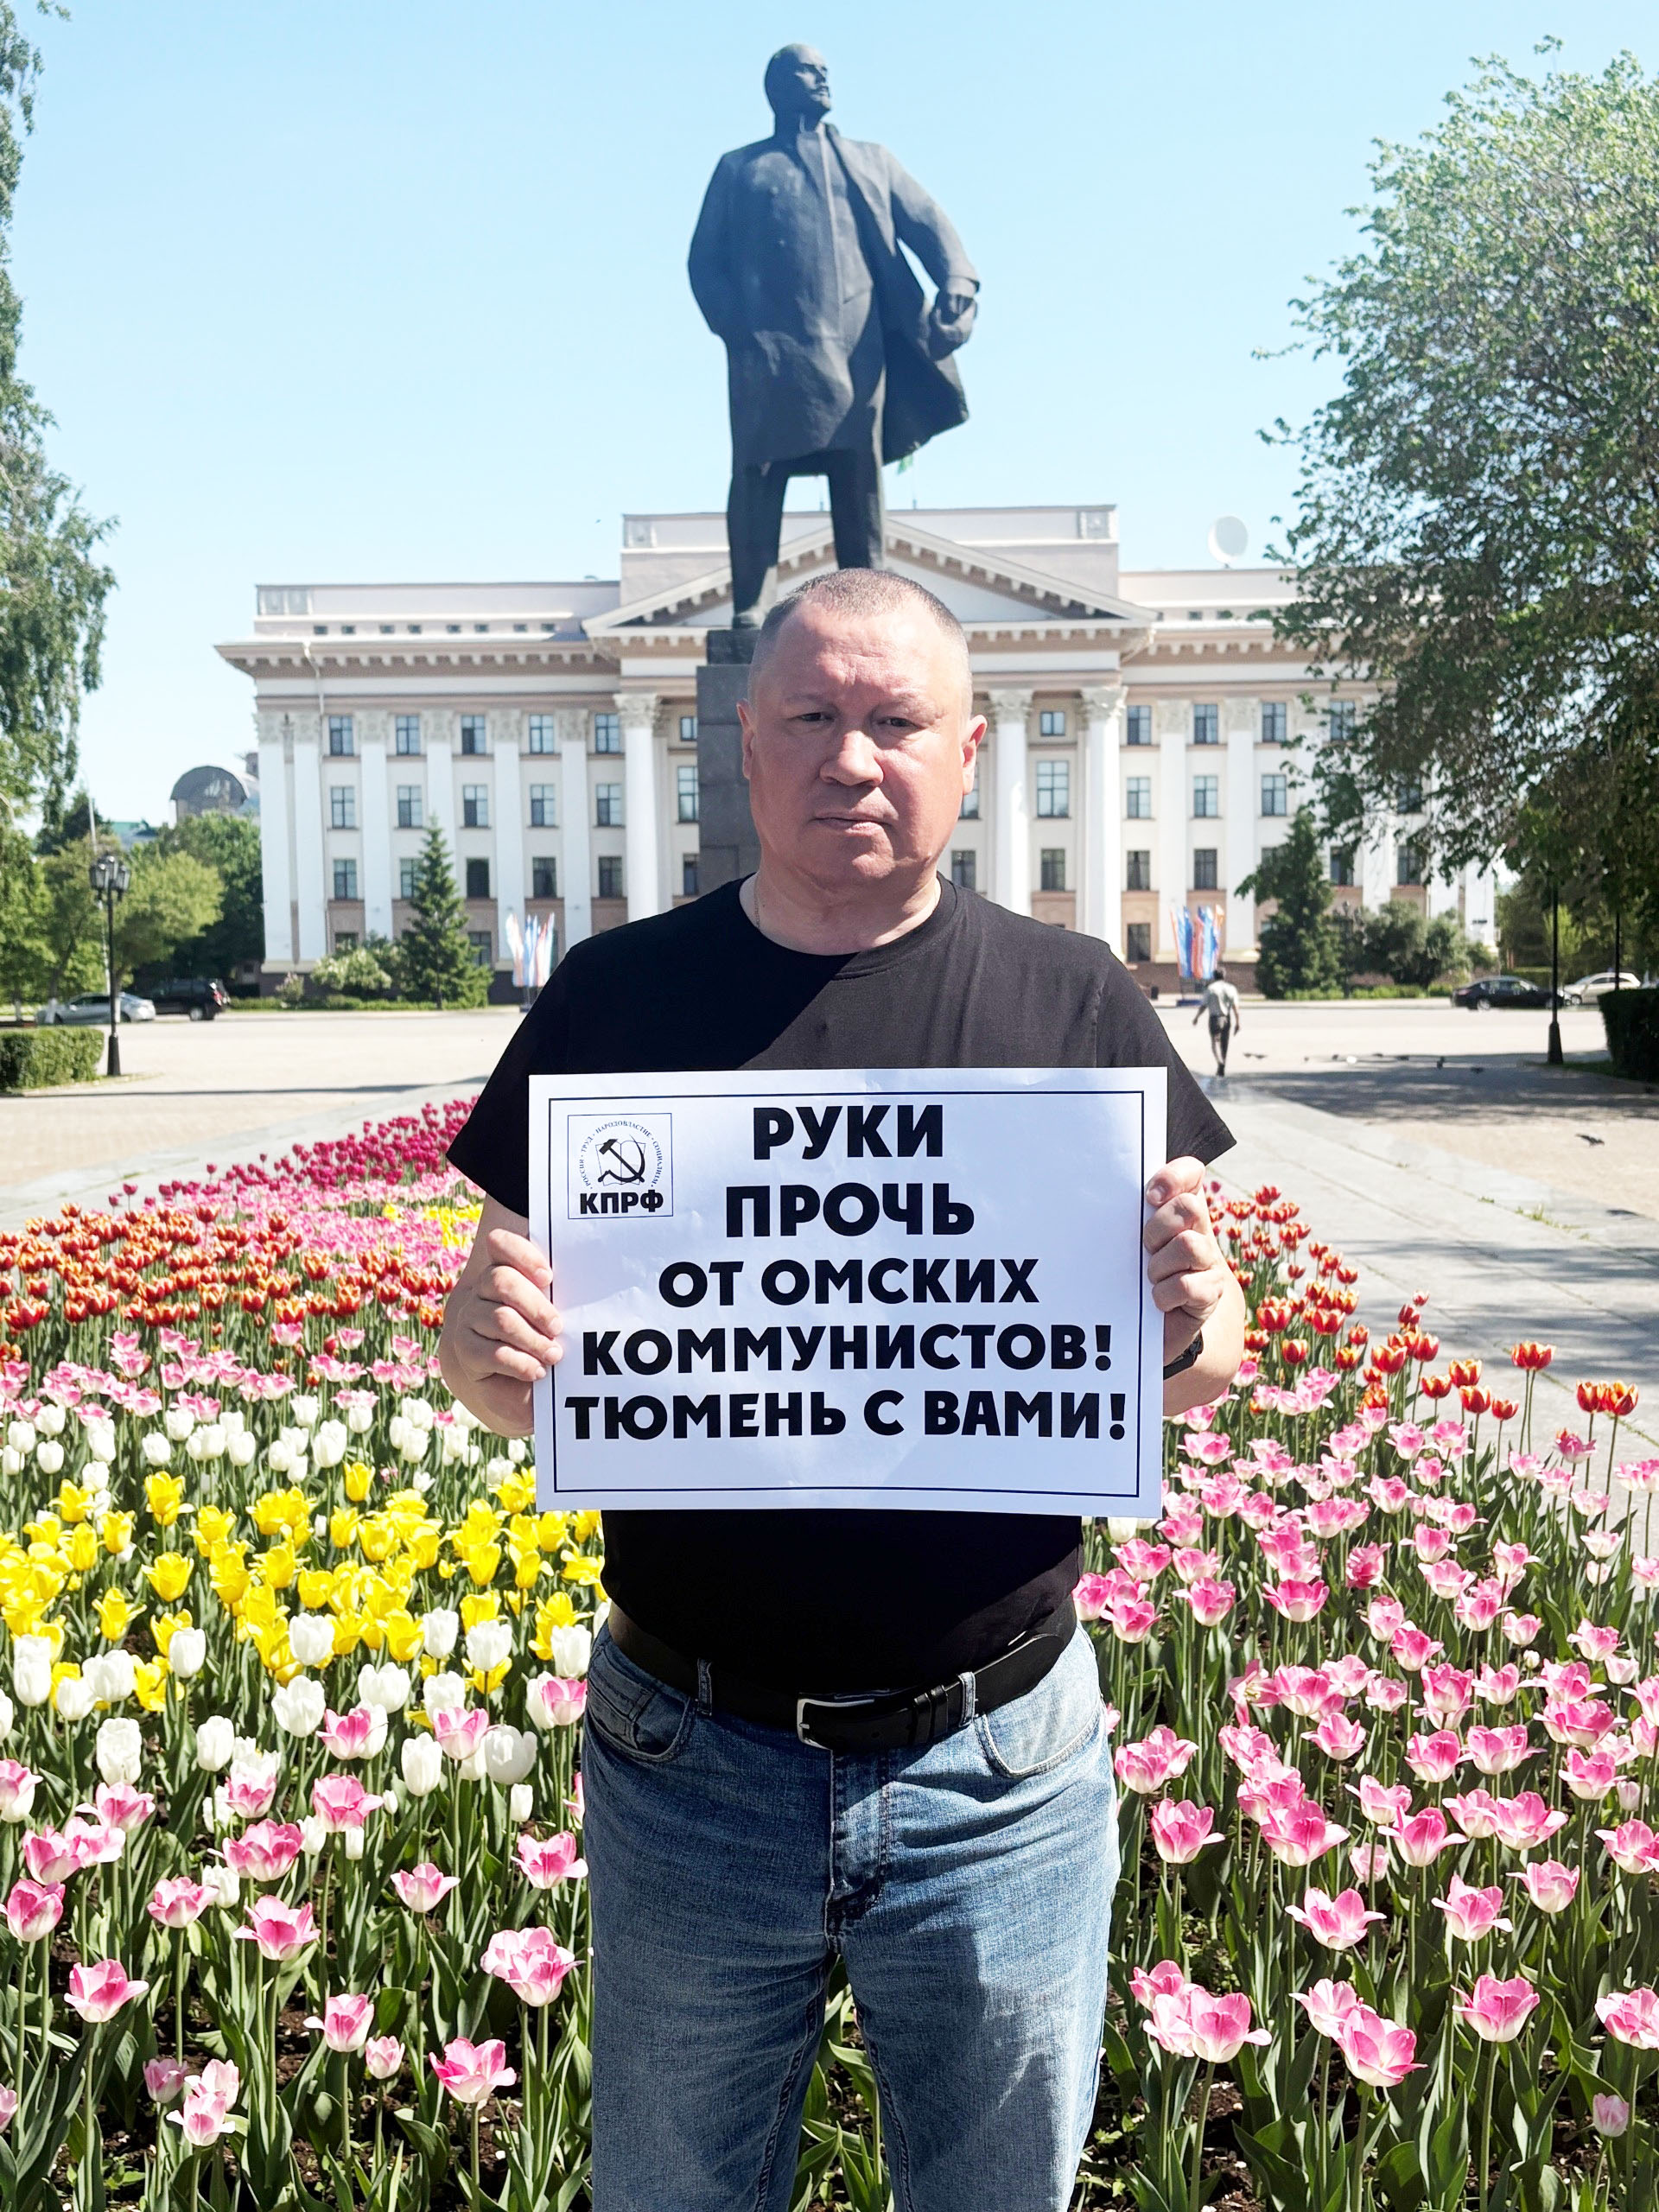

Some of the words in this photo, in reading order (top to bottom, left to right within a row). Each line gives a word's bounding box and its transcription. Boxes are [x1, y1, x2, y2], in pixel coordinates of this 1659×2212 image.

[753, 1105, 943, 1160] РУКИ
[581, 1190, 663, 1214] КПРФ
[727, 1183, 974, 1237] ПРОЧЬ
[659, 1262, 744, 1307] ОТ
[761, 1258, 1039, 1306] ОМСКИХ
[583, 1324, 1111, 1375] КОММУНИСТОВ!
[565, 1392, 846, 1440] ТЮМЕНЬ
[864, 1390, 904, 1435] С
[925, 1391, 1125, 1440] ВАМИ!
